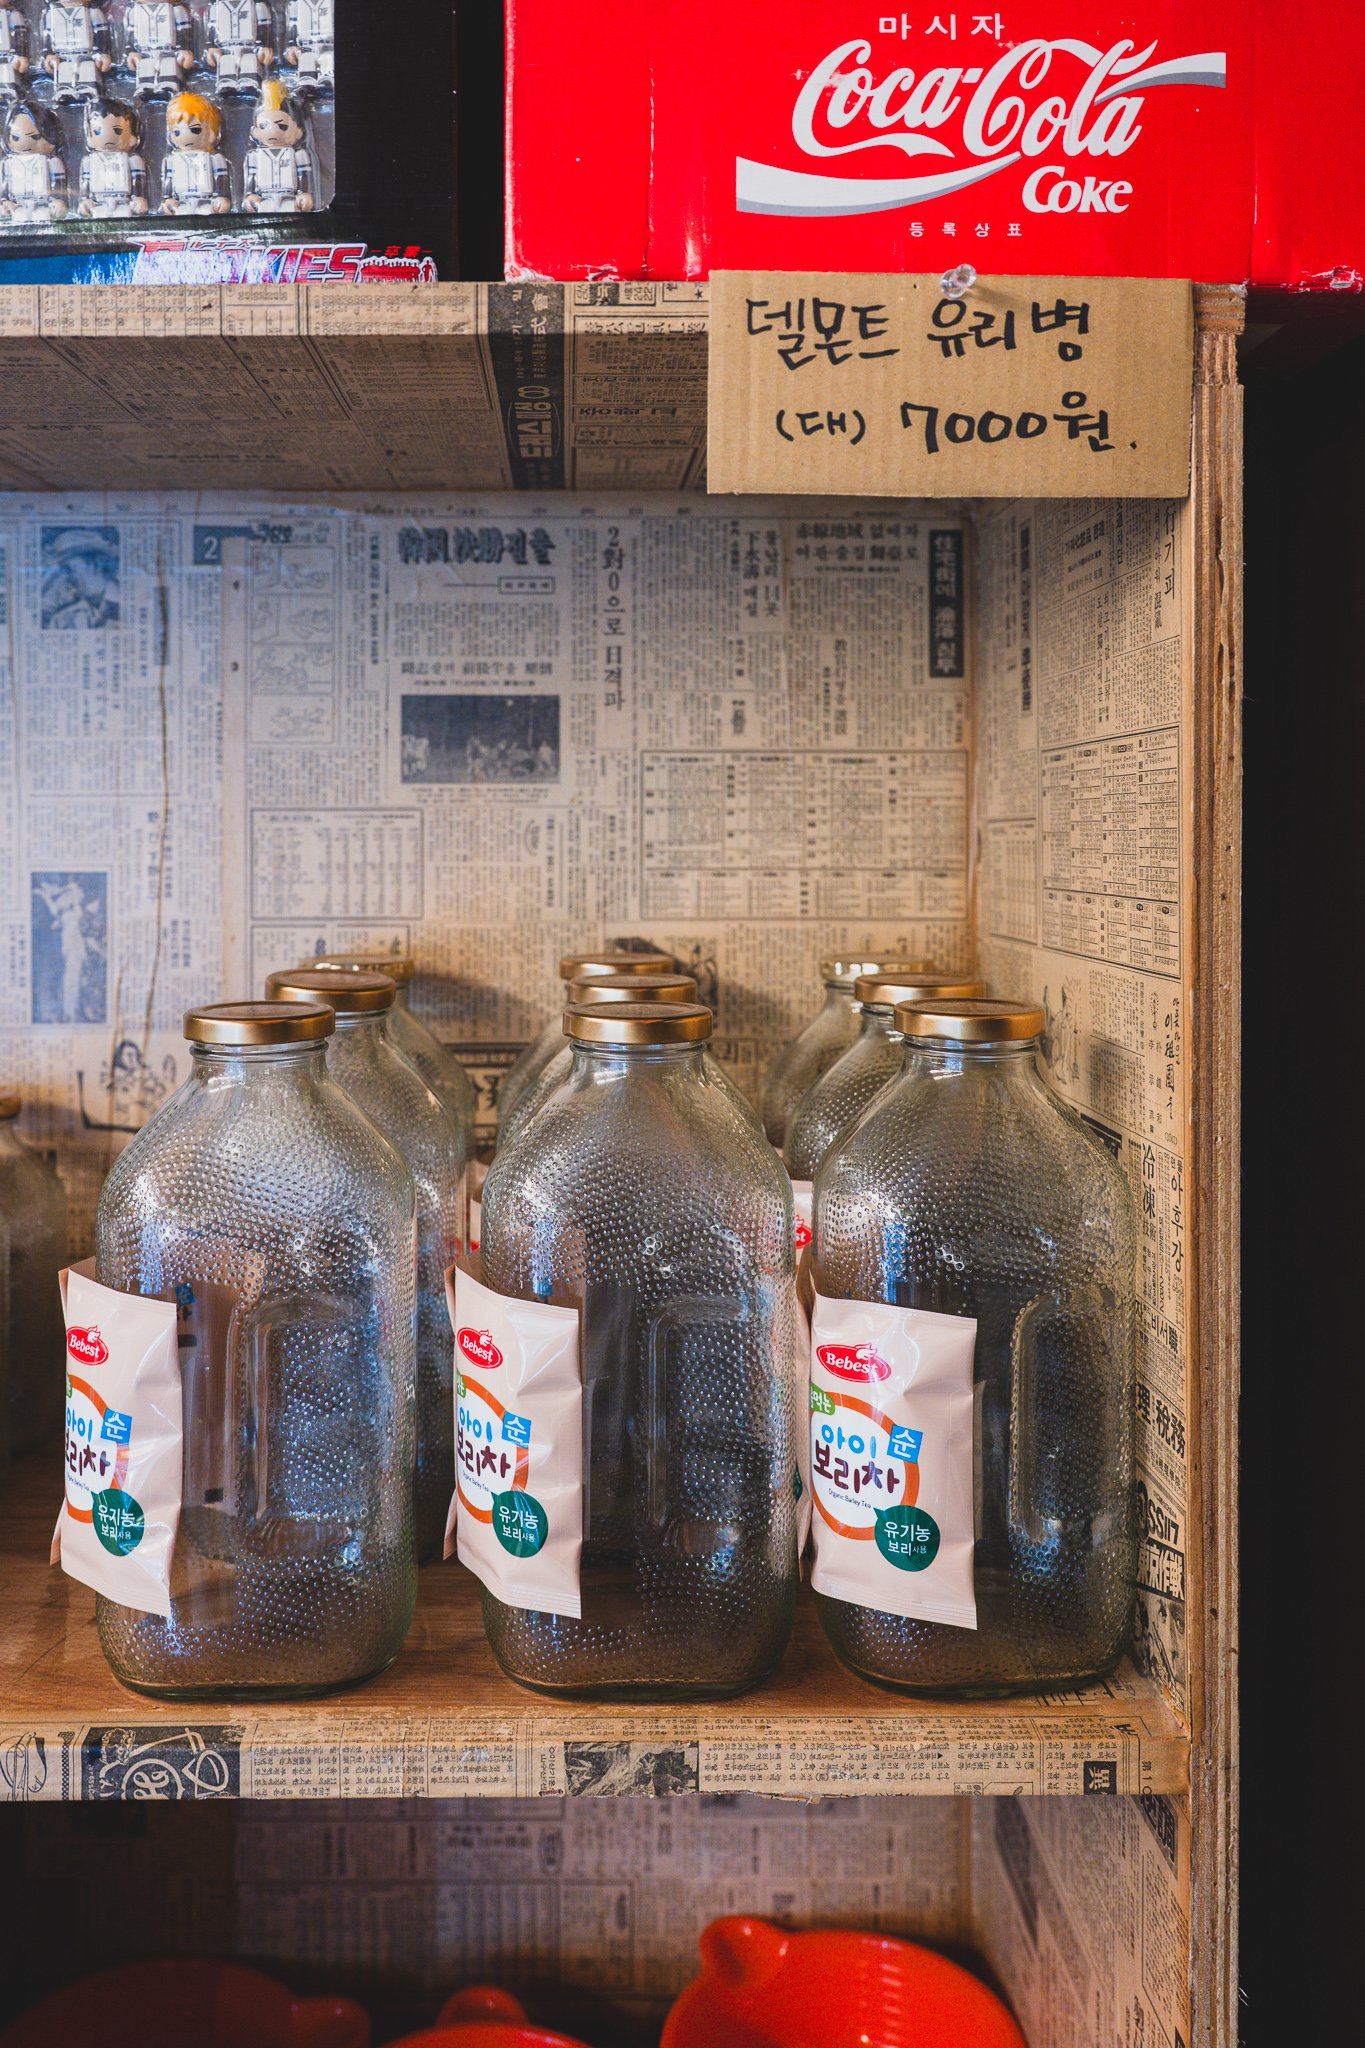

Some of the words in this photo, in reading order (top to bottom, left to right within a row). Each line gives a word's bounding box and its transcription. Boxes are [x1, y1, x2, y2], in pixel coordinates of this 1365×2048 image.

[879, 13, 1005, 41] 마시자
[792, 38, 1158, 158] Coca-Cola
[1023, 165, 1133, 214] Coke
[909, 222, 1022, 238] 등록상표
[126, 238, 367, 282] OKIES
[745, 298, 899, 371] 델몬트
[926, 298, 1090, 362] 유리병
[776, 409, 866, 446] (대)
[900, 392, 1138, 455] 7000원.
[203, 536, 220, 561] 2
[69, 1333, 101, 1359] Bebest
[462, 1334, 494, 1363] Bebest
[825, 1351, 879, 1378] Bebest
[66, 1407, 93, 1442] 아이
[104, 1411, 128, 1441] 순
[459, 1406, 493, 1443] 아이
[504, 1416, 528, 1445] 순
[821, 1423, 877, 1459] 아이
[891, 1429, 917, 1459] 순
[813, 1439, 900, 1494] 보리차
[828, 1487, 845, 1502] Organic
[844, 1494, 861, 1509] Barley
[860, 1499, 872, 1509] Tea
[97, 1504, 135, 1528] 유기농
[498, 1504, 539, 1530] 유기농
[883, 1521, 931, 1542] 유기농
